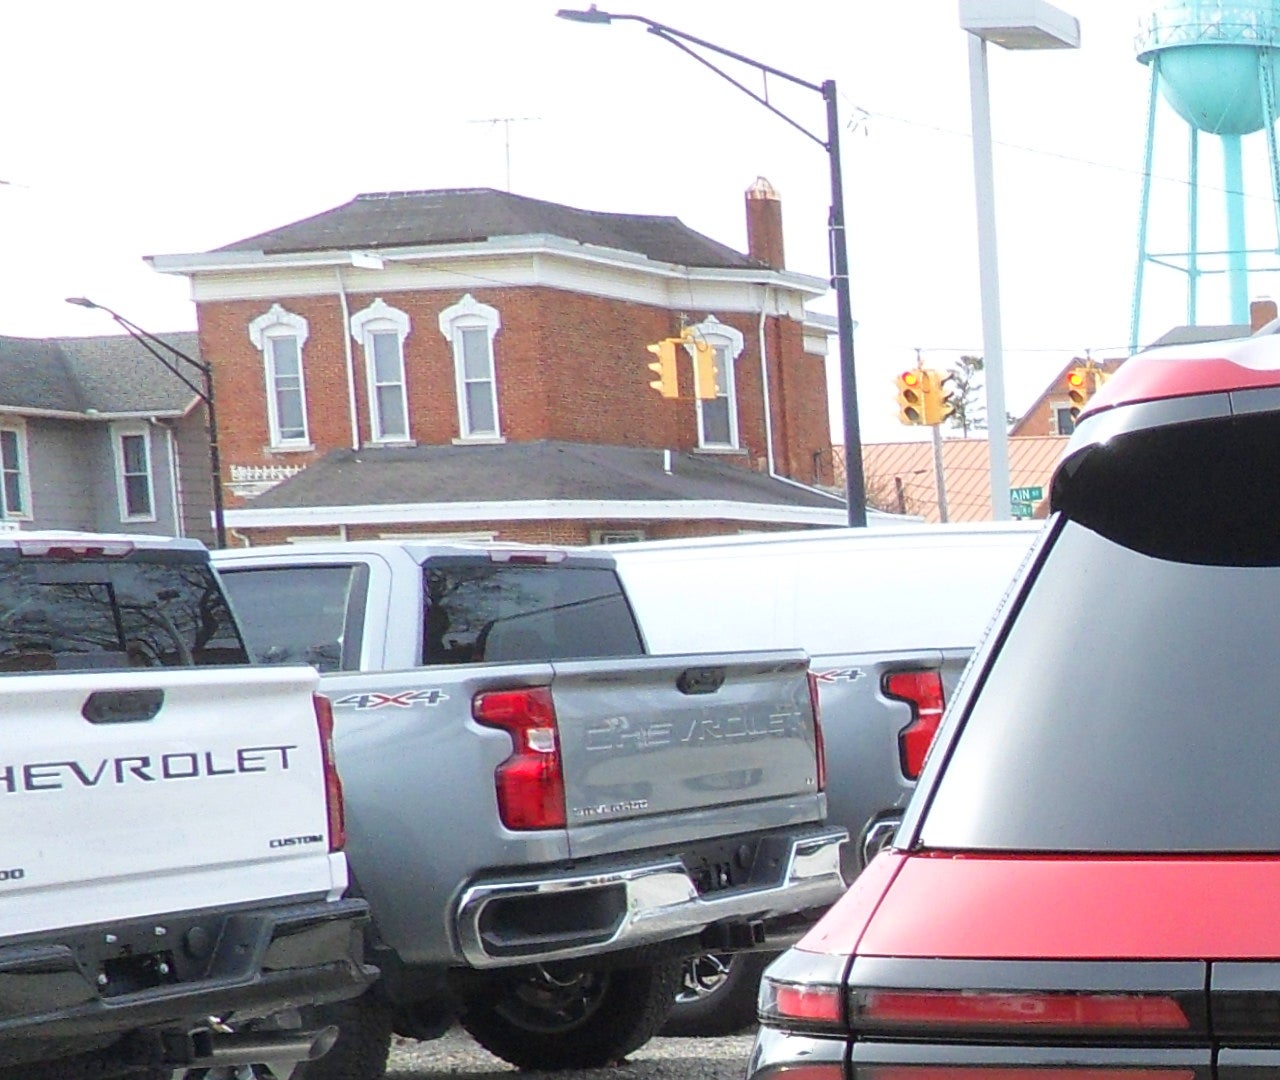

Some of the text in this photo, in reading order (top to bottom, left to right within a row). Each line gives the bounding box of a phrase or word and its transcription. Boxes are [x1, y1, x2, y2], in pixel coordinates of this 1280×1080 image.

[1011, 489, 1031, 502] AIN
[807, 667, 866, 682] X4
[269, 834, 324, 848] CUSTOM
